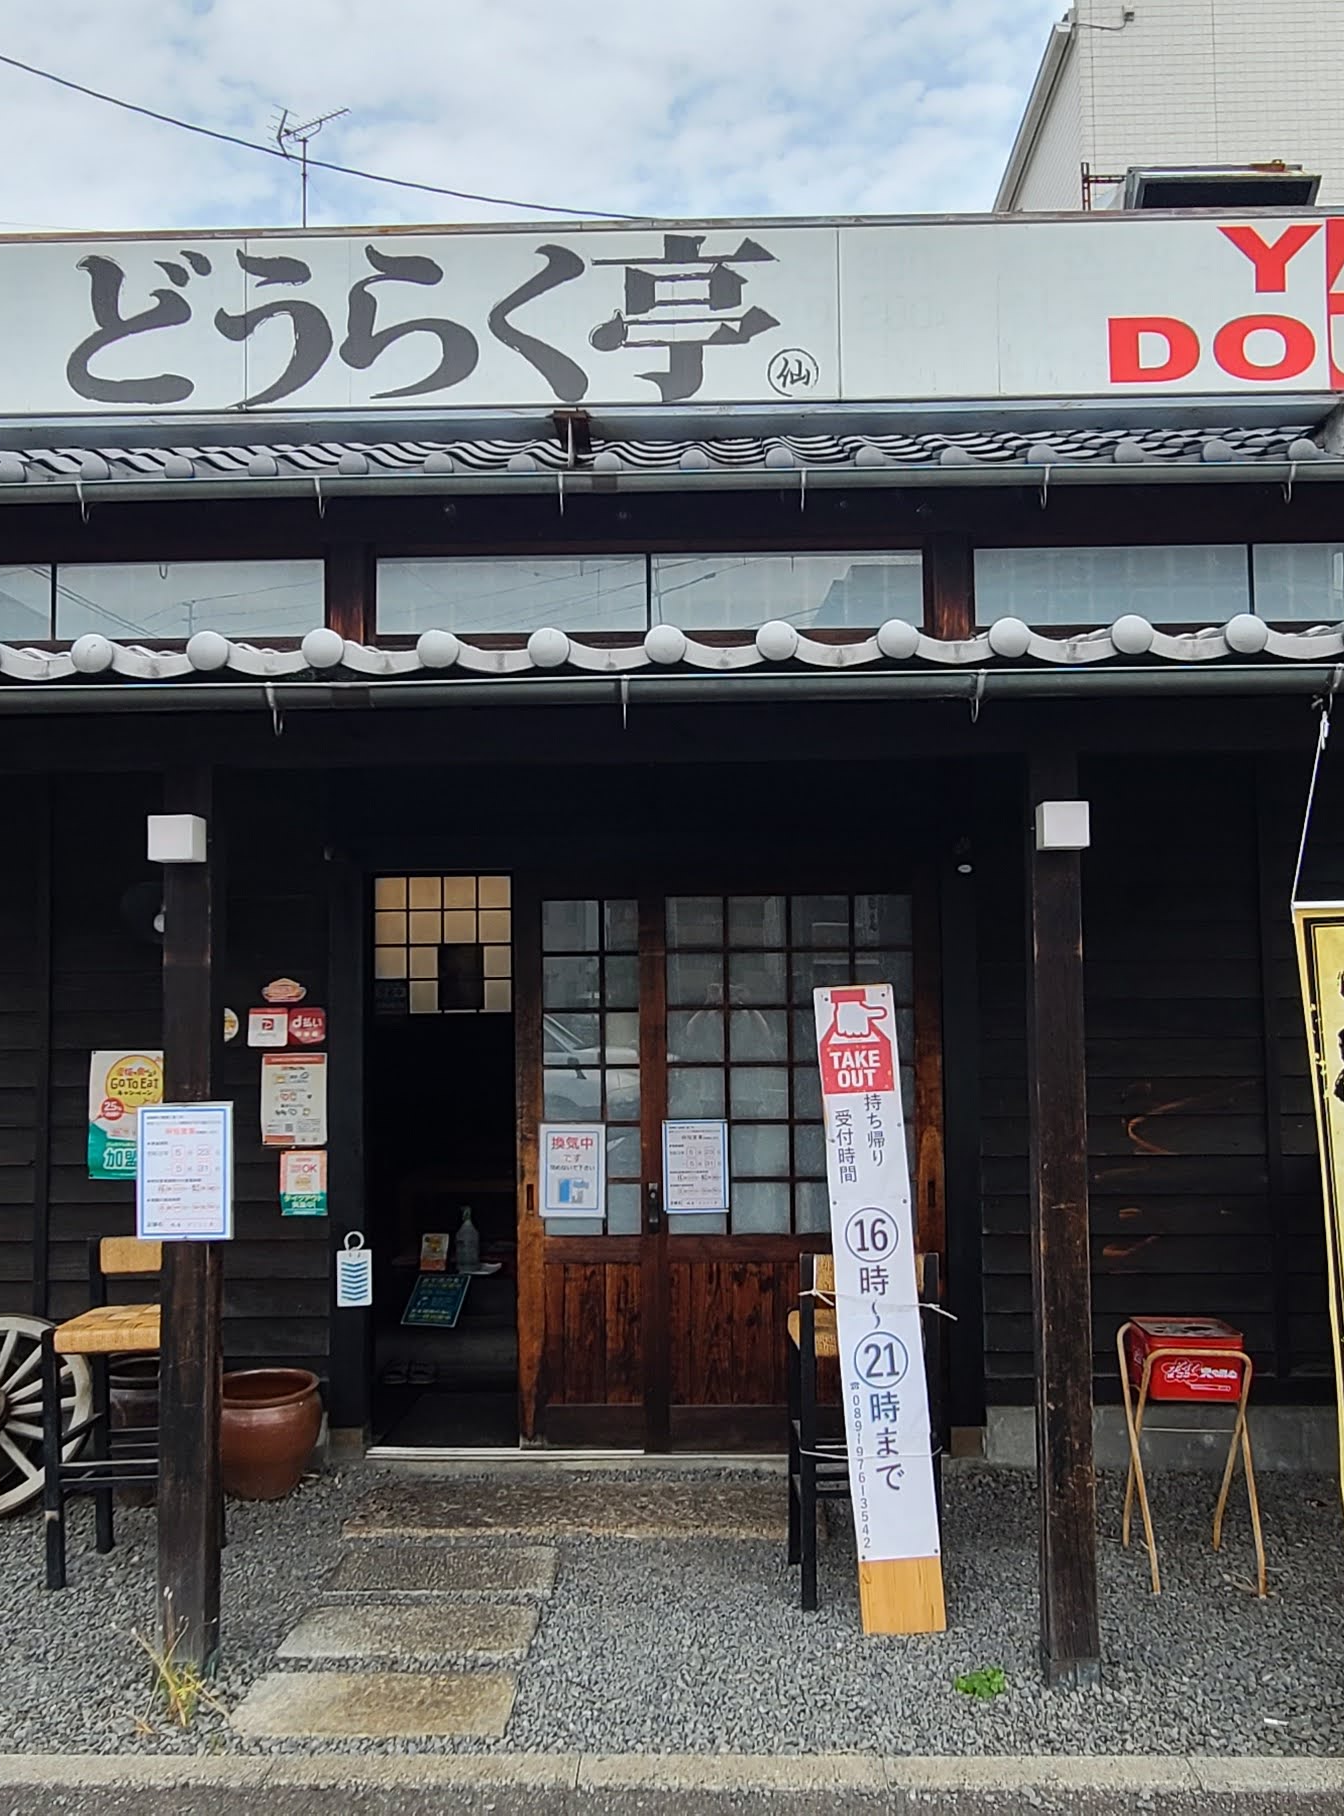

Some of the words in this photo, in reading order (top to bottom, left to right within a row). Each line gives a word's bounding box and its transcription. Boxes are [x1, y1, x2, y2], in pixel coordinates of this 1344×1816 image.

[66, 233, 781, 409] どうらく亭
[772, 353, 814, 394] 仙
[292, 1015, 322, 1028] d払い
[829, 1048, 881, 1071] TAKE
[837, 1067, 877, 1089] OUT
[551, 1136, 594, 1150] 換気中
[833, 1108, 858, 1184] 受付時間
[862, 1092, 885, 1168] 持ち帰り
